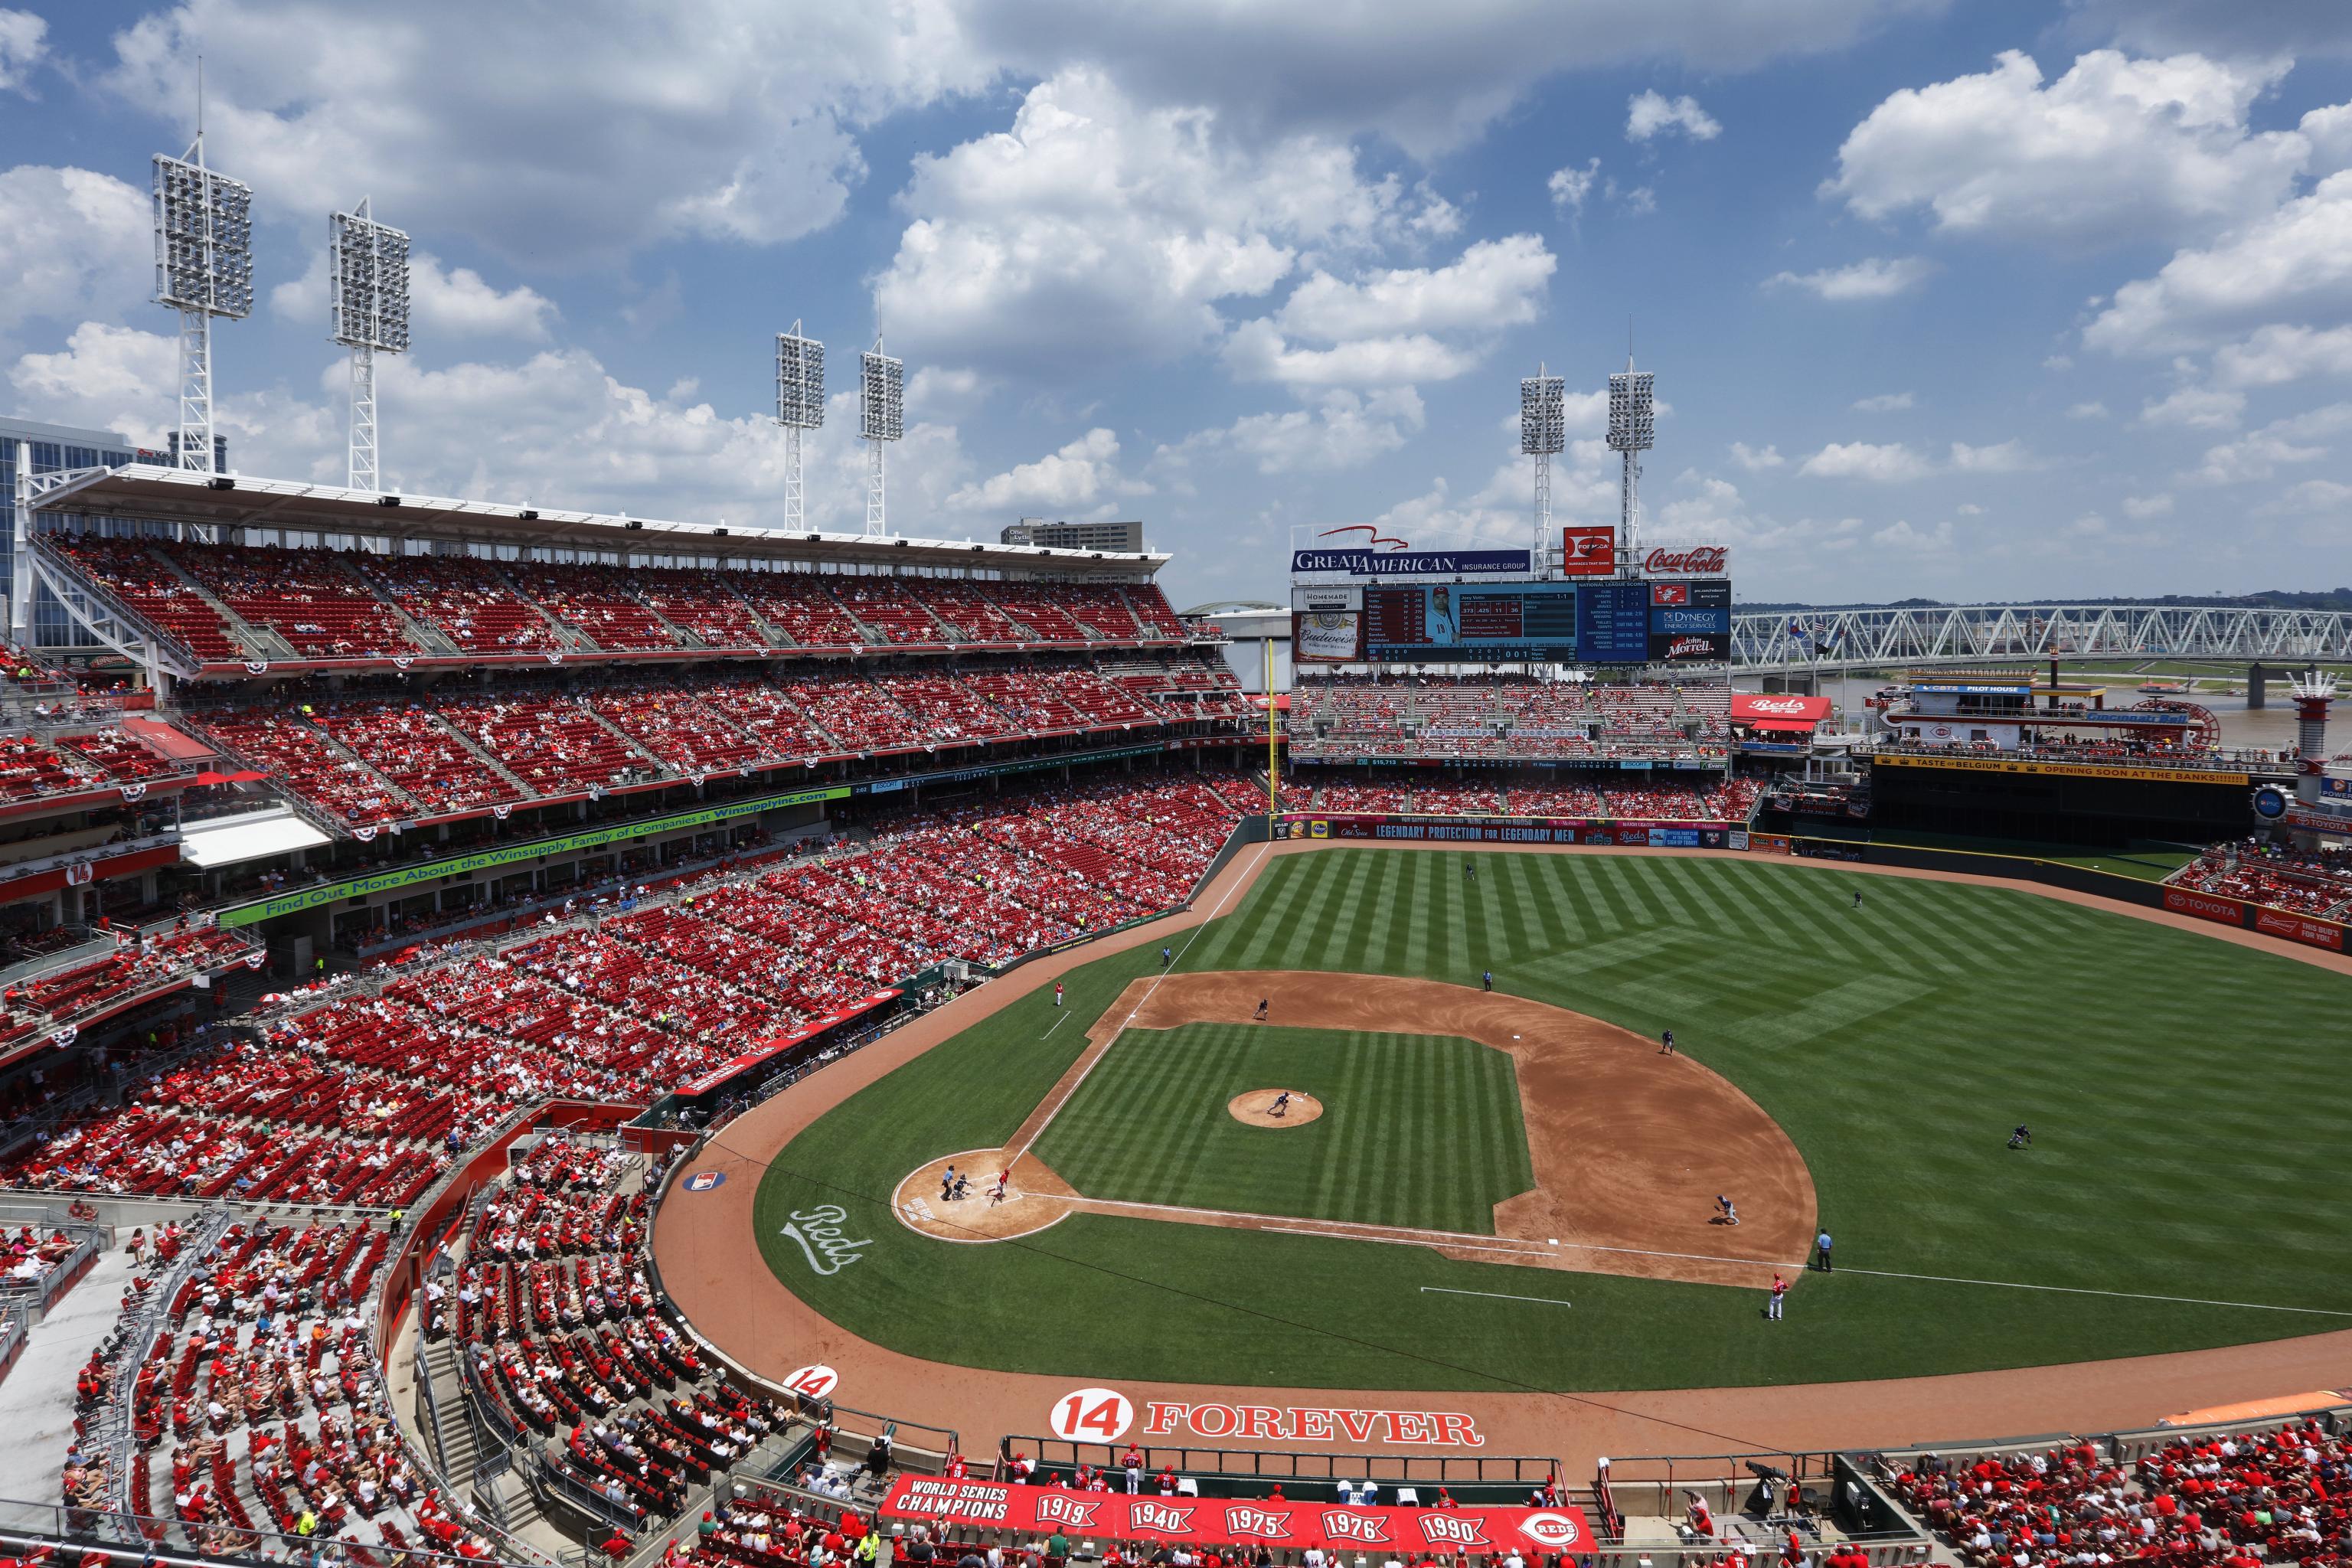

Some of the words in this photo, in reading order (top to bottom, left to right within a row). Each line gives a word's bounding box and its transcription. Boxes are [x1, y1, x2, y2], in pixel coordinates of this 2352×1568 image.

[1296, 552, 1362, 570] GREAT
[1357, 556, 1455, 572] AMERICAN
[1645, 546, 1728, 573] Coca-Cola
[1674, 612, 1716, 622] DYNEGY
[1299, 629, 1357, 644] Budweiser
[1683, 636, 1701, 645] John
[1664, 641, 1715, 658] Morrell
[1748, 700, 1805, 711] Reds
[2086, 712, 2156, 722] Cincinnati
[2159, 714, 2187, 723] Bell
[1956, 761, 2001, 769] BELGIUM
[2045, 766, 2092, 775] OPENING
[2096, 769, 2128, 777] SOON
[876, 781, 898, 789] ESCORT
[1377, 825, 1424, 838] LEGENDARY
[1429, 827, 1481, 839] PROTECTION
[1485, 830, 1498, 839] FOR
[1501, 828, 1551, 841] LEGENDARY
[1554, 830, 1574, 842] MEN
[2311, 819, 2347, 831] TOYOTA
[1620, 830, 1646, 843] Reds
[266, 897, 304, 915] Find
[310, 888, 345, 903] Out
[353, 876, 400, 893] More
[404, 864, 455, 882] About
[461, 855, 485, 868] the
[490, 841, 567, 862] Winsupply
[572, 832, 612, 847] Family
[616, 828, 629, 838] of
[633, 815, 697, 834] Companies
[700, 814, 710, 822] at
[714, 791, 827, 818] Winsupplyinc.com
[71, 864, 89, 884] 14
[2188, 899, 2236, 917] TOYOTA
[2262, 917, 2296, 929] Budweiser
[2301, 922, 2317, 932] THIS
[2318, 926, 2339, 937] BUD'S
[2301, 930, 2315, 939] FOR
[2317, 934, 2331, 943] YOU.
[779, 1204, 874, 1275] Reds
[789, 1369, 833, 1396] 14
[1066, 1396, 1121, 1436] 14
[1143, 1402, 1484, 1446] FOREVER
[911, 1481, 957, 1497] WORLD
[959, 1485, 1008, 1501] SERIES
[897, 1494, 1008, 1521] CHAMPIONS
[1041, 1499, 1085, 1524] 1919
[1135, 1504, 1181, 1530] 1940
[1230, 1508, 1278, 1535] 1975
[1326, 1514, 1376, 1540] 1976
[1424, 1517, 1472, 1542] 1990
[1536, 1524, 1576, 1534] REDS
[1311, 1559, 1320, 1567] 14
